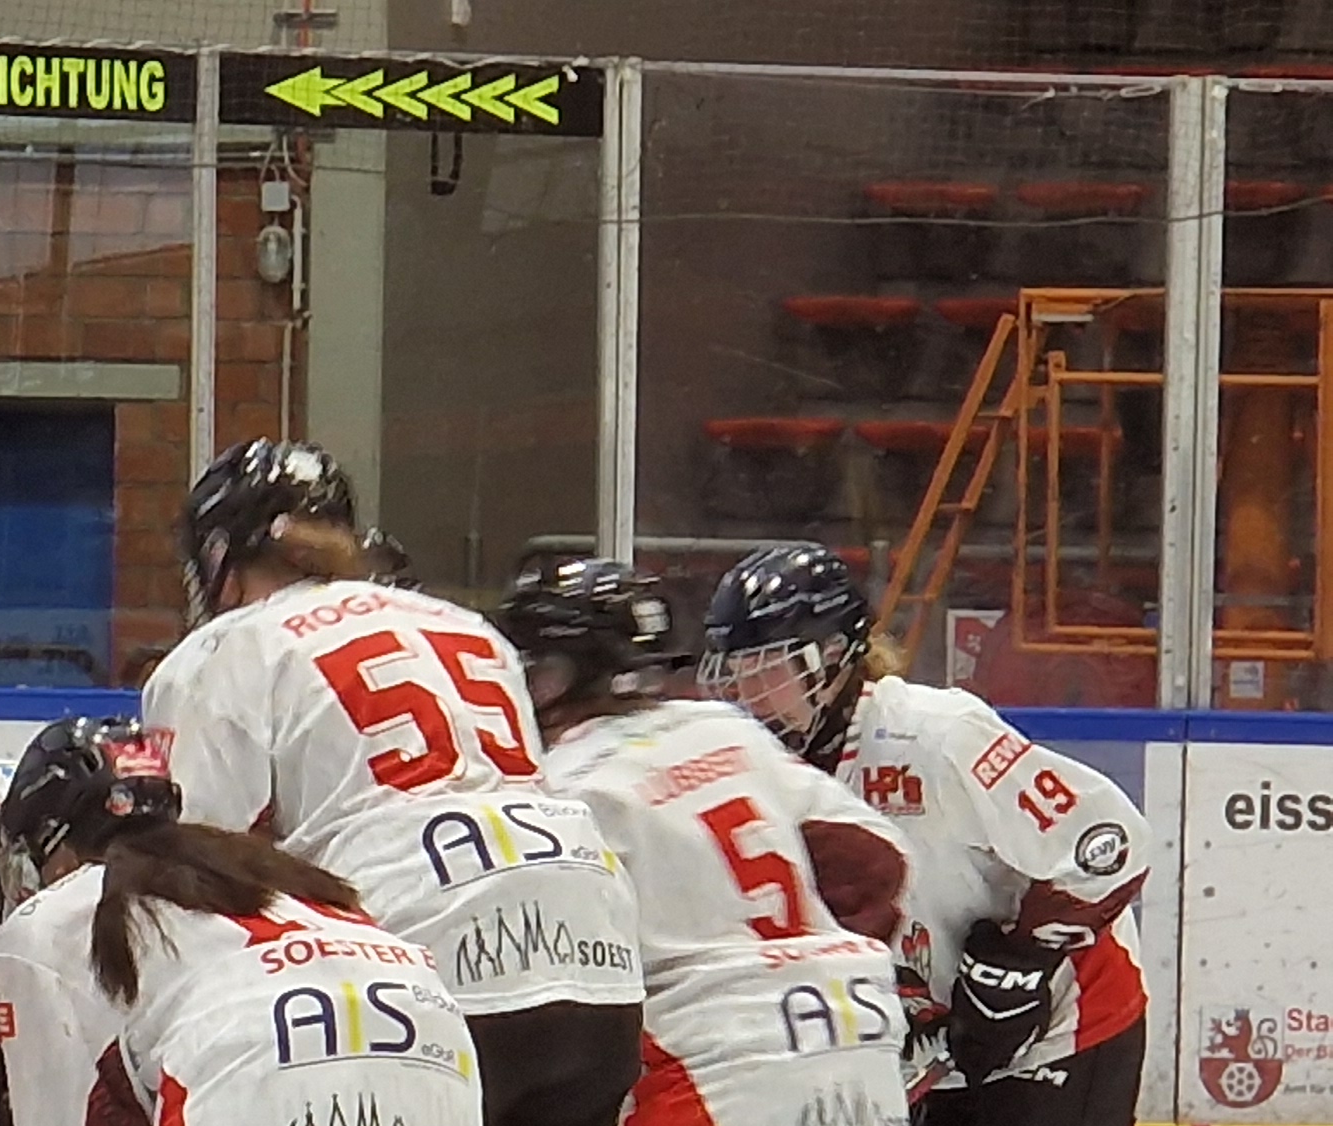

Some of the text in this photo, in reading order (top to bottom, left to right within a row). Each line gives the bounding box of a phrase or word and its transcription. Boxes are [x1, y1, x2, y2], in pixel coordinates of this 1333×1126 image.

[315, 628, 540, 790] 55
[975, 734, 1030, 787] REW
[1018, 769, 1078, 832] 19
[422, 801, 562, 888] AIS
[699, 796, 814, 941] 5
[260, 939, 437, 975] SOESTER E
[579, 940, 633, 972] SOEST
[273, 982, 416, 1064] AIS
[780, 977, 890, 1052] AIS
[1287, 1007, 1333, 1032] Sta
